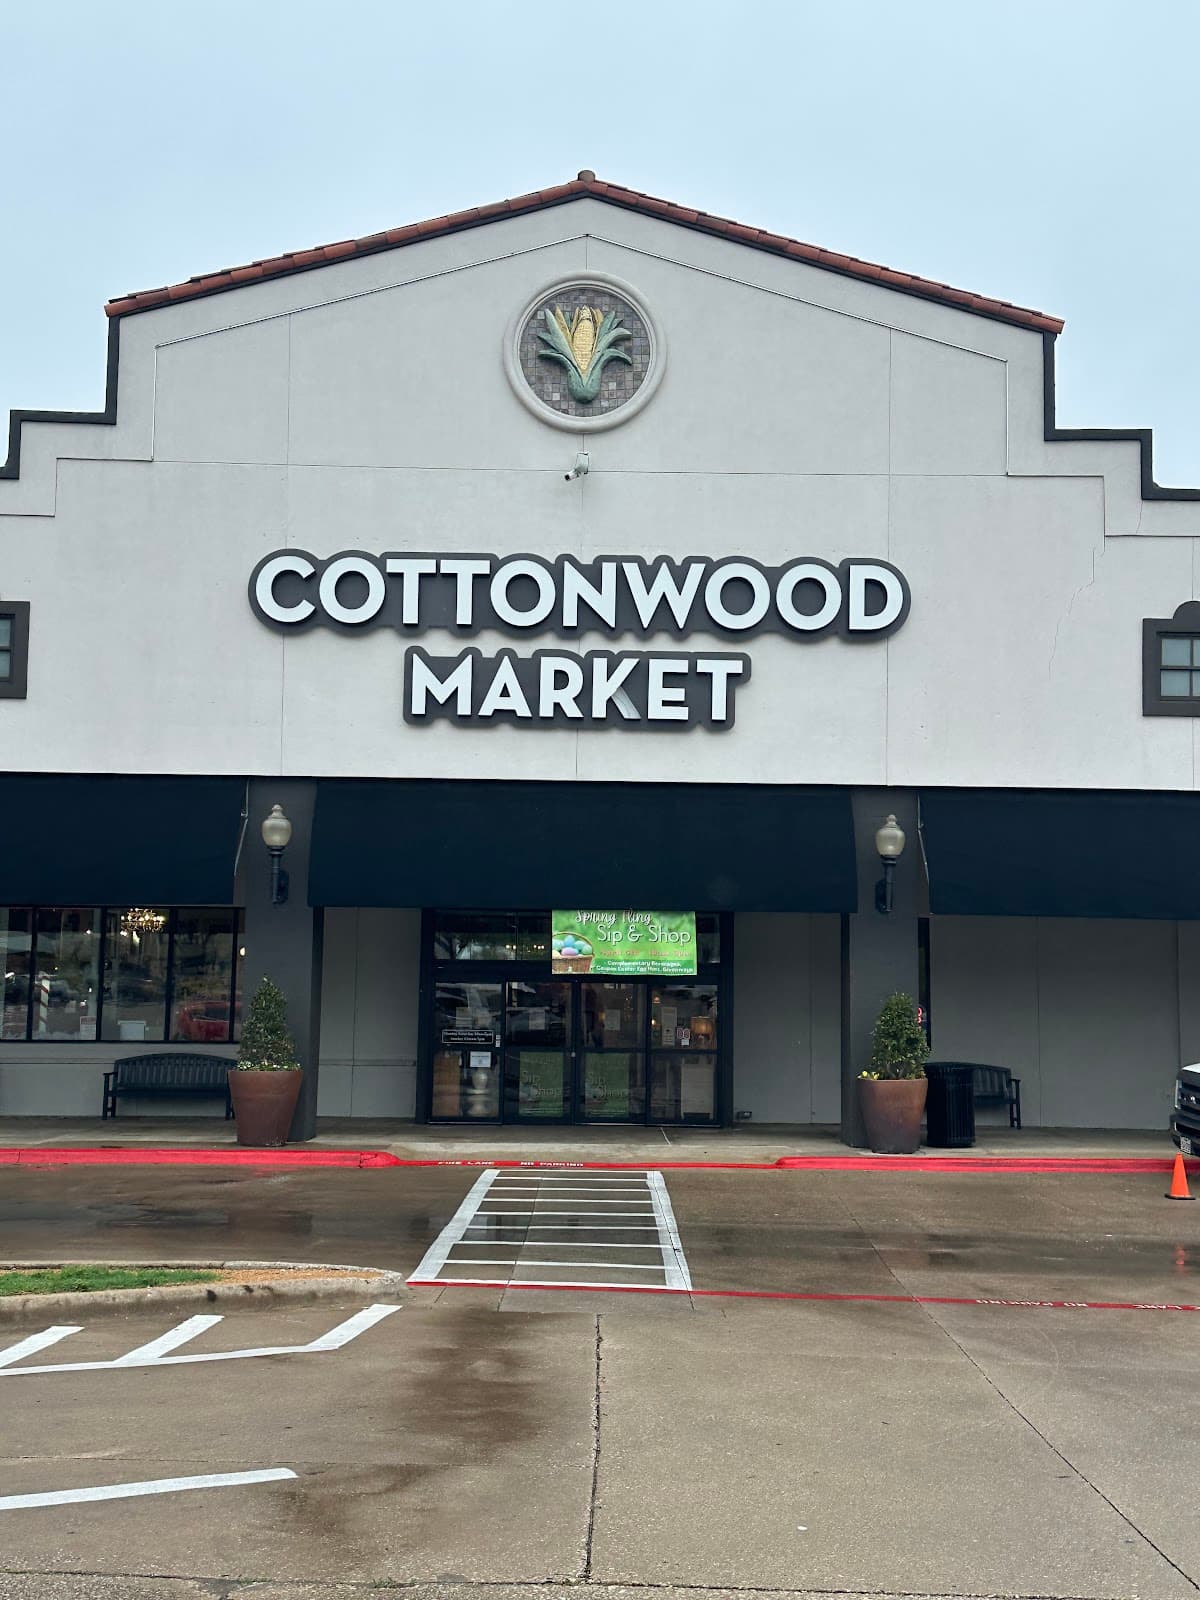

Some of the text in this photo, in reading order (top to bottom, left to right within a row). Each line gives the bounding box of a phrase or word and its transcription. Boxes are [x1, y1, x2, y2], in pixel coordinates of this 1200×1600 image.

[255, 555, 904, 631] COTTONWOOD
[411, 653, 744, 721] MARKET
[597, 925, 692, 946] Sip & Shop
